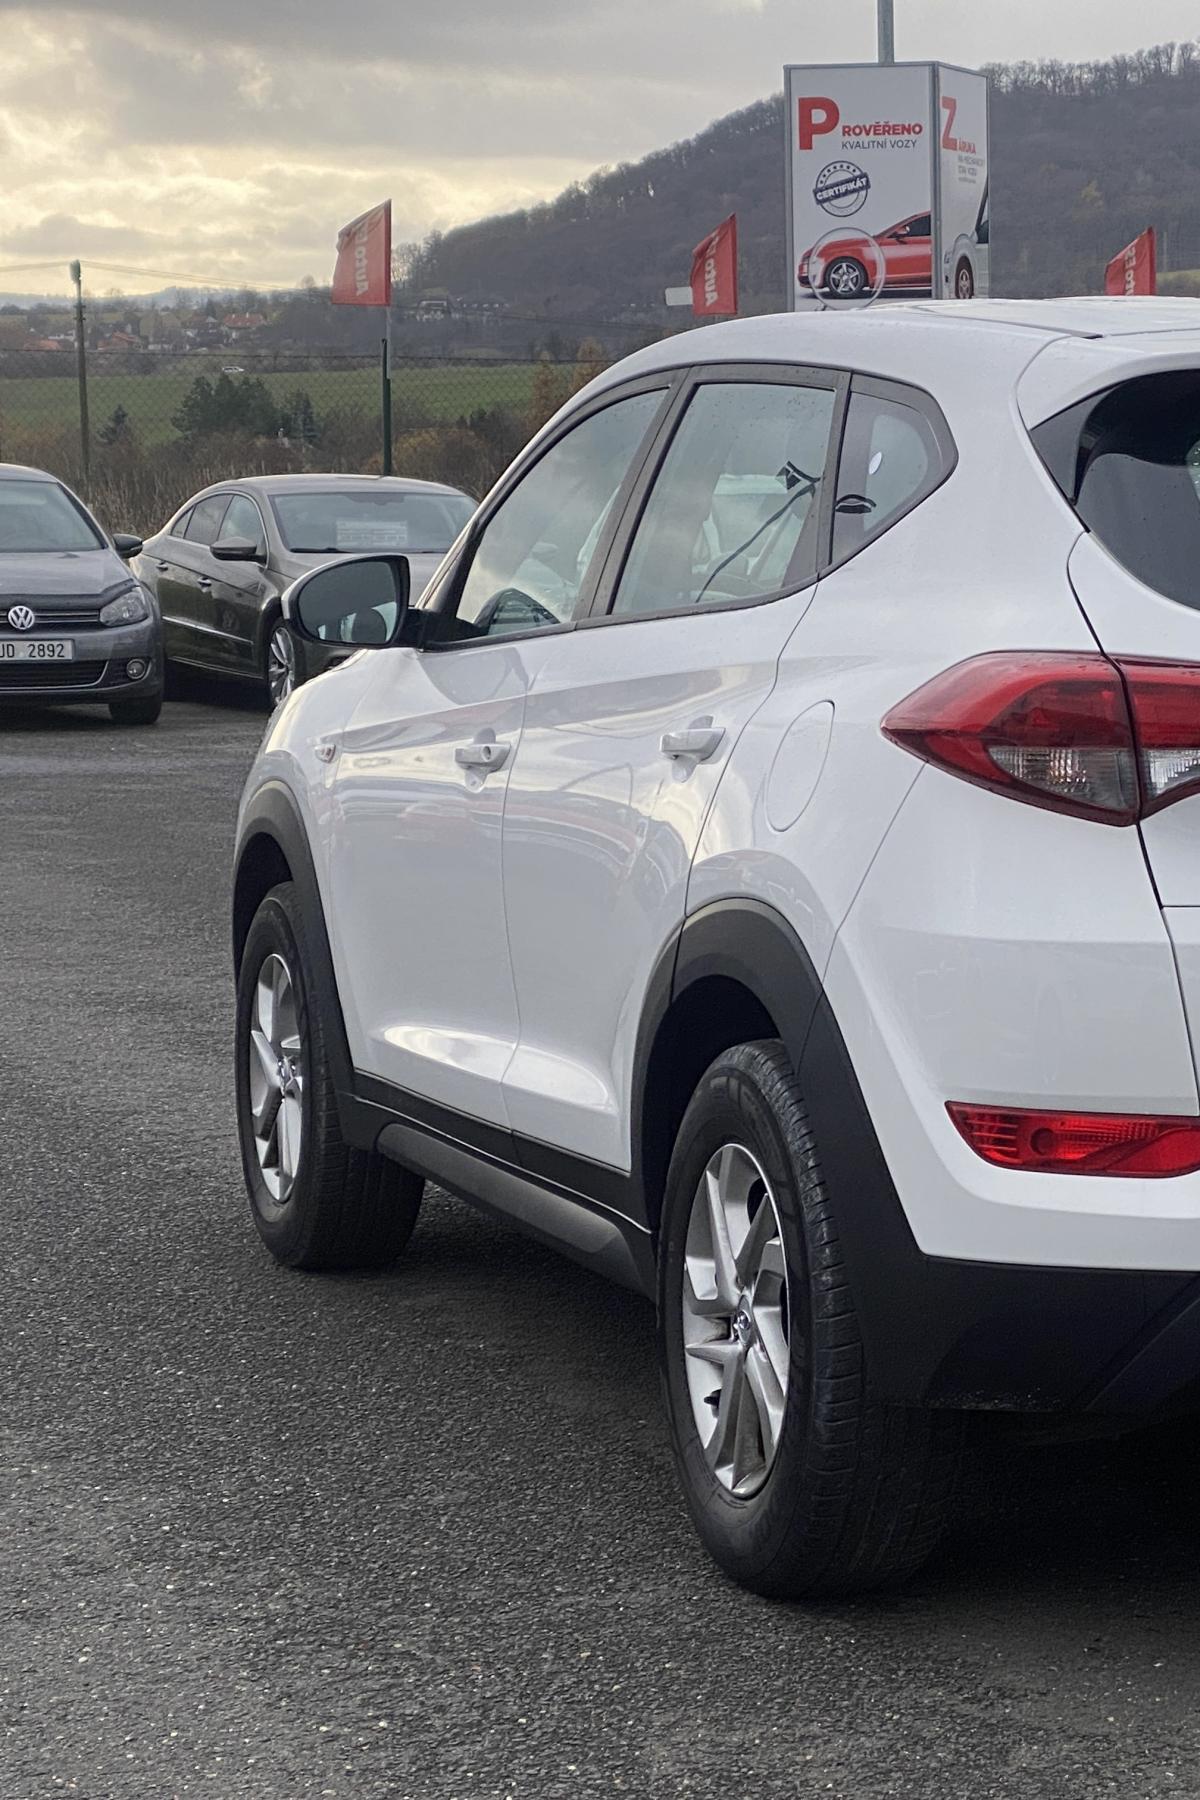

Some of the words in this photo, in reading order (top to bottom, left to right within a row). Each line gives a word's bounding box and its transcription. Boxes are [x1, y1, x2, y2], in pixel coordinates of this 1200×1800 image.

[841, 139, 887, 150] KVALITNÍ
[889, 139, 917, 149] VOZY
[816, 177, 868, 201] CERTIFIKÁT
[27, 643, 65, 658] 2892
